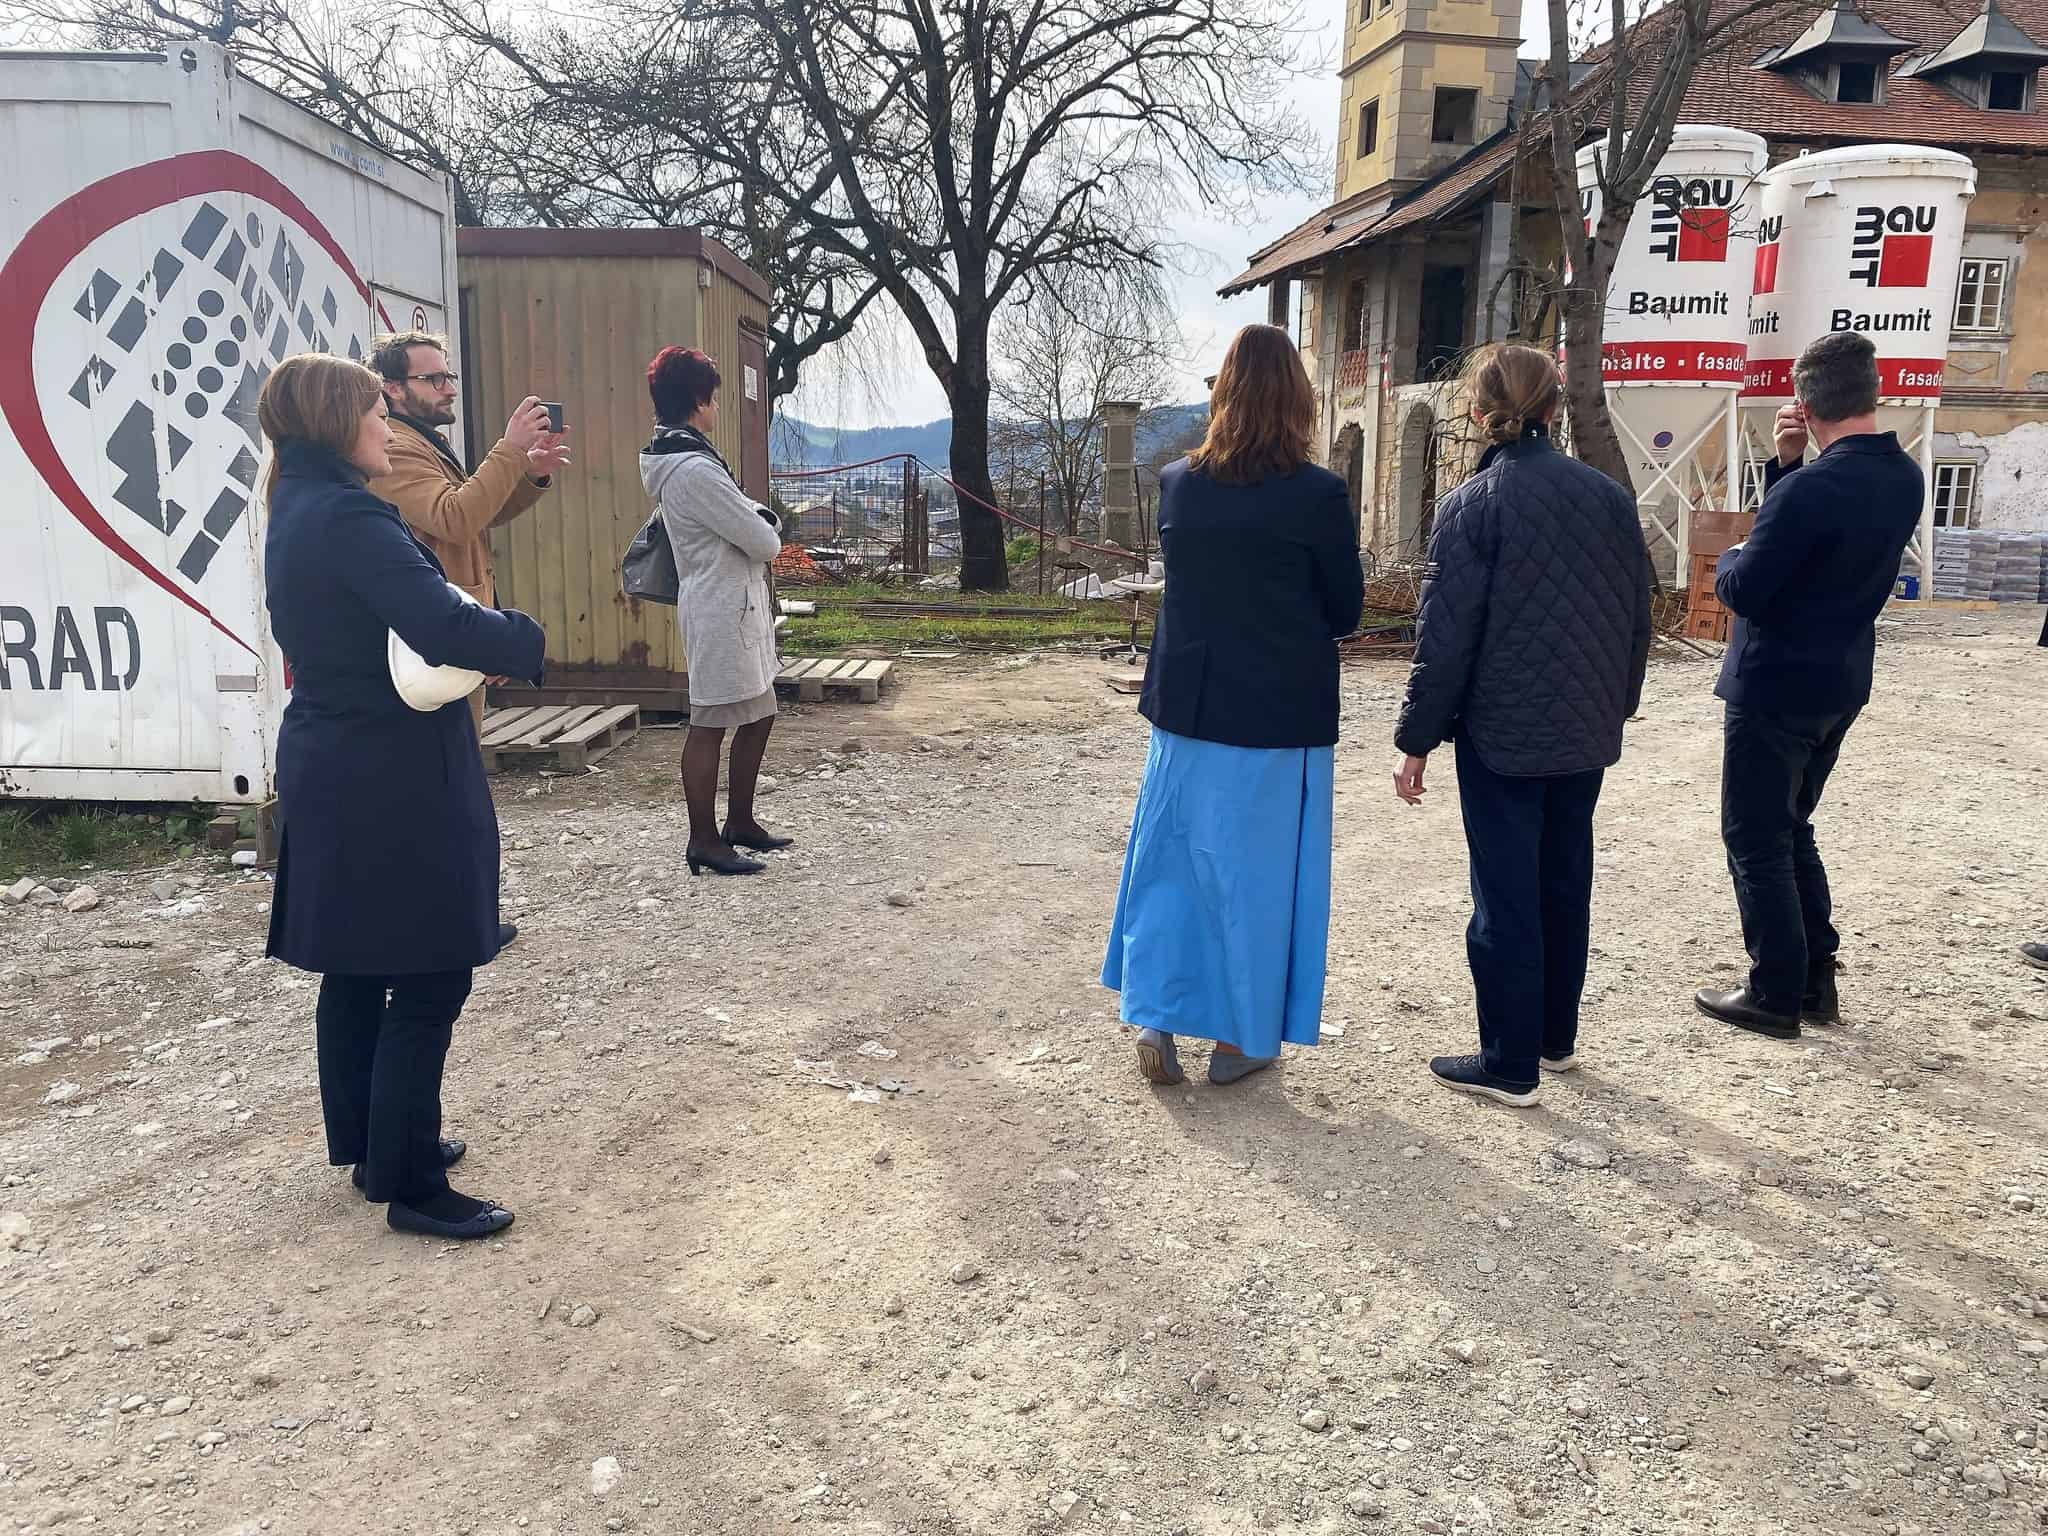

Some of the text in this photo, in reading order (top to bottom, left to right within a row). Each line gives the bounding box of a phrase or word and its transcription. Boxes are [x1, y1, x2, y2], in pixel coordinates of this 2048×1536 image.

[1629, 290, 1729, 316] Baumit
[1831, 308, 1932, 332] Baumit
[1697, 352, 1745, 372] fasade
[1744, 369, 1772, 388] meti
